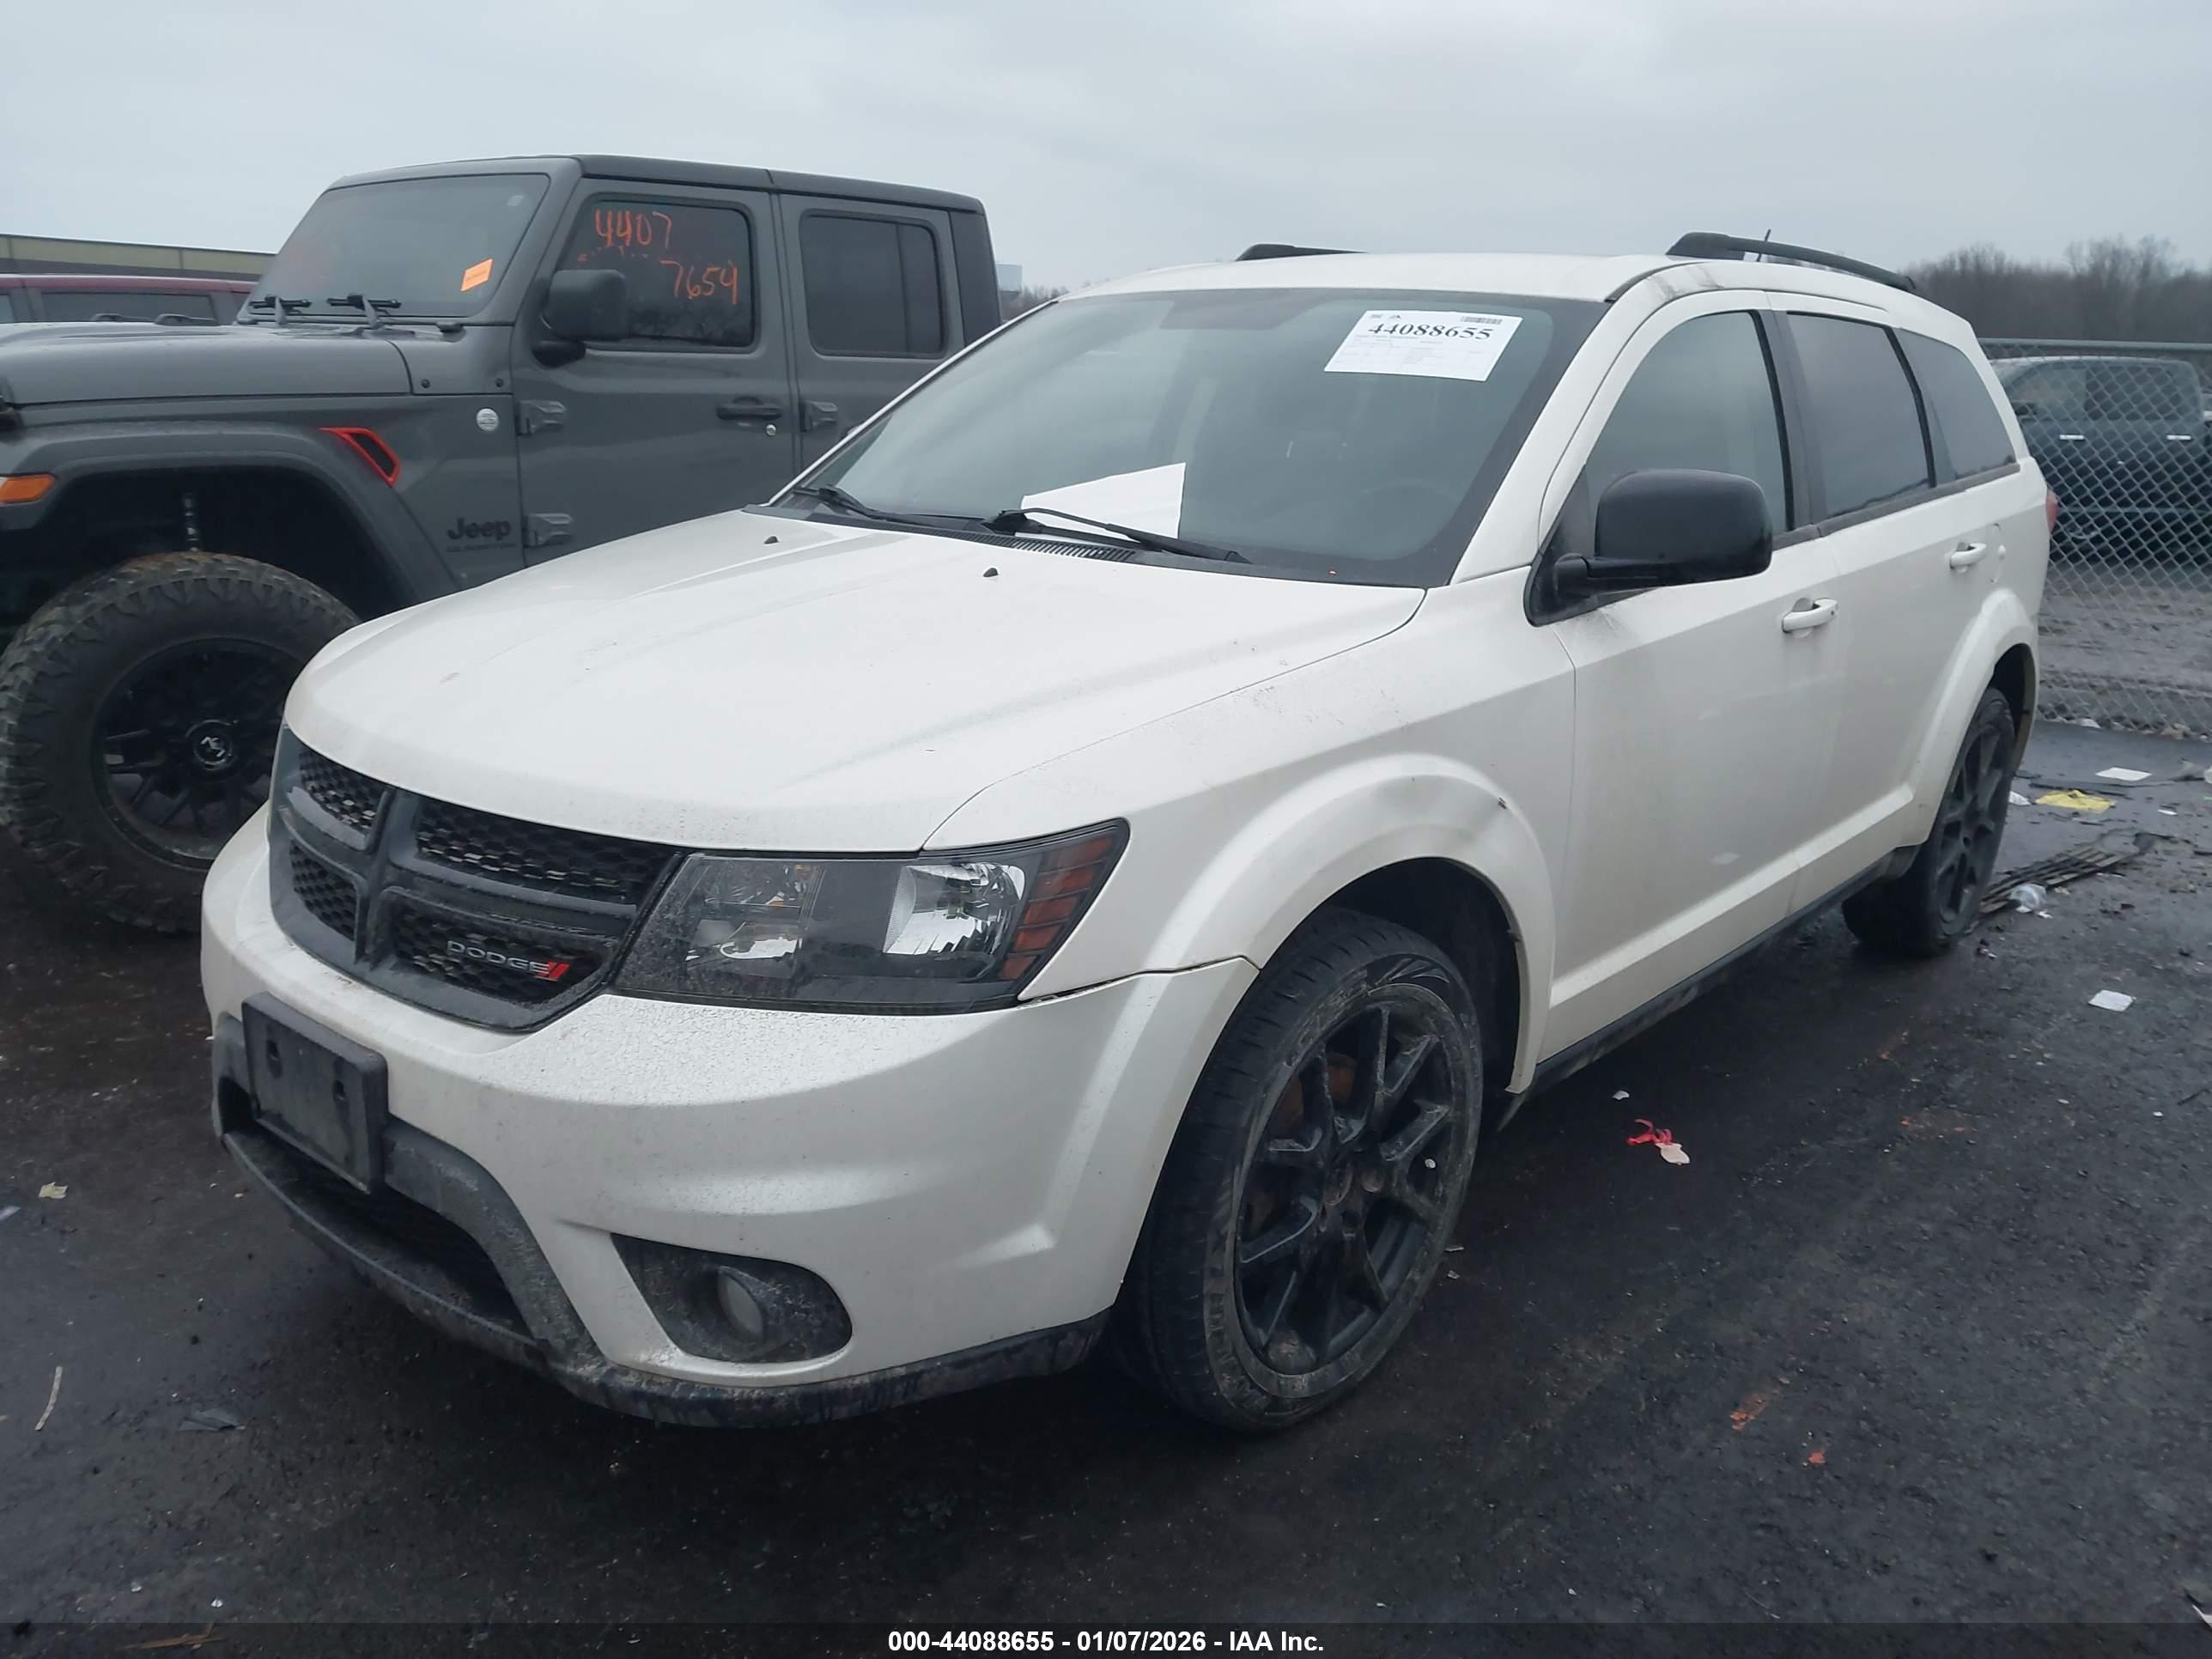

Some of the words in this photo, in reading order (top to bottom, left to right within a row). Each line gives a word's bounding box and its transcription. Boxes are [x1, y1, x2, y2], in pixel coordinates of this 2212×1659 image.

[594, 209, 672, 249] 4407
[1367, 323, 1494, 341] 44088655
[447, 517, 512, 541] Jeep
[447, 940, 550, 975] DODGE
